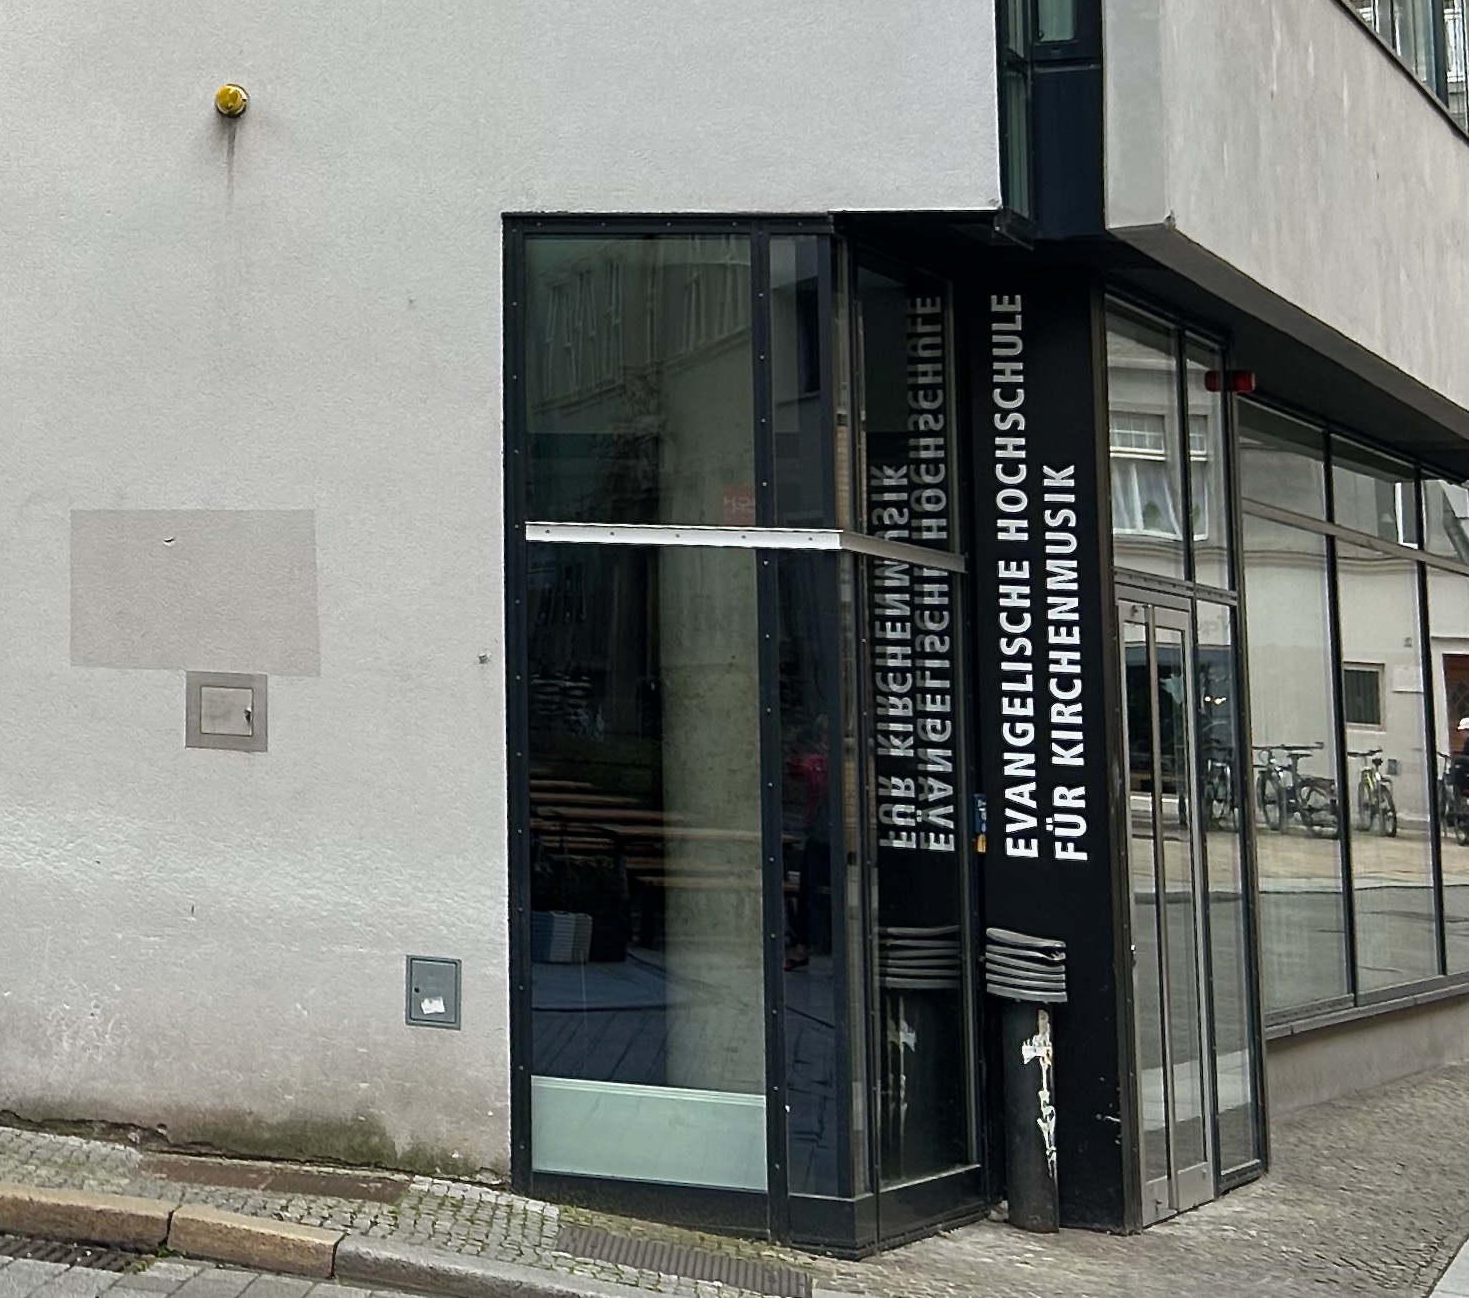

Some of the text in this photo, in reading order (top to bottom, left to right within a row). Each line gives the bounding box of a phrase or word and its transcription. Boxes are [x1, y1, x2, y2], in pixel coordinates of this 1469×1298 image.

[990, 294, 1039, 859] EVANGELISCHE HOCHSCHULE
[1042, 464, 1088, 861] FÜR KIRCHENMUSIK
